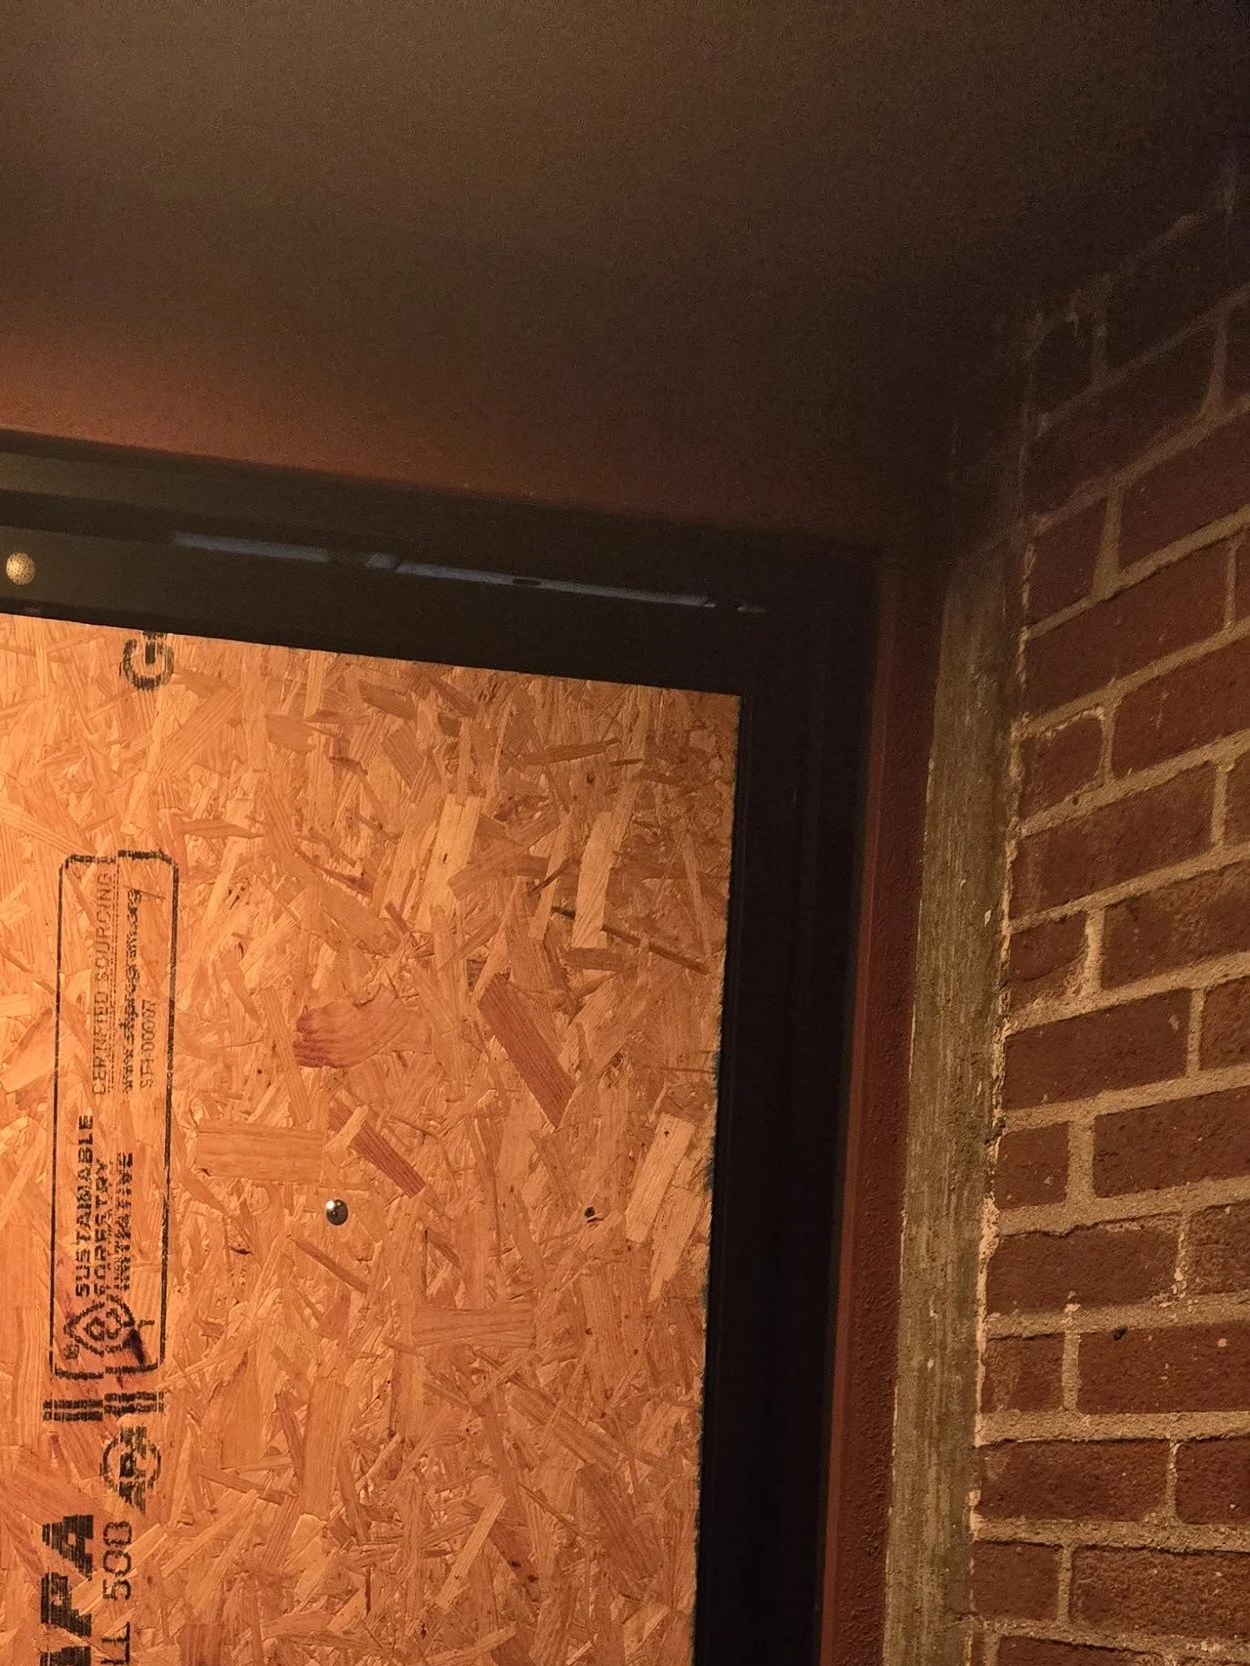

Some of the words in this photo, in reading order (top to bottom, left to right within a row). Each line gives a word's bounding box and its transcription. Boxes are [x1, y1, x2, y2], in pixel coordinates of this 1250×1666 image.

[93, 871, 112, 981] SOURCING
[91, 991, 109, 1095] CERTIFIED
[75, 1116, 93, 1298] SUSTAINABLE
[93, 1157, 113, 1298] FORESTRY
[101, 1520, 132, 1601] 500
